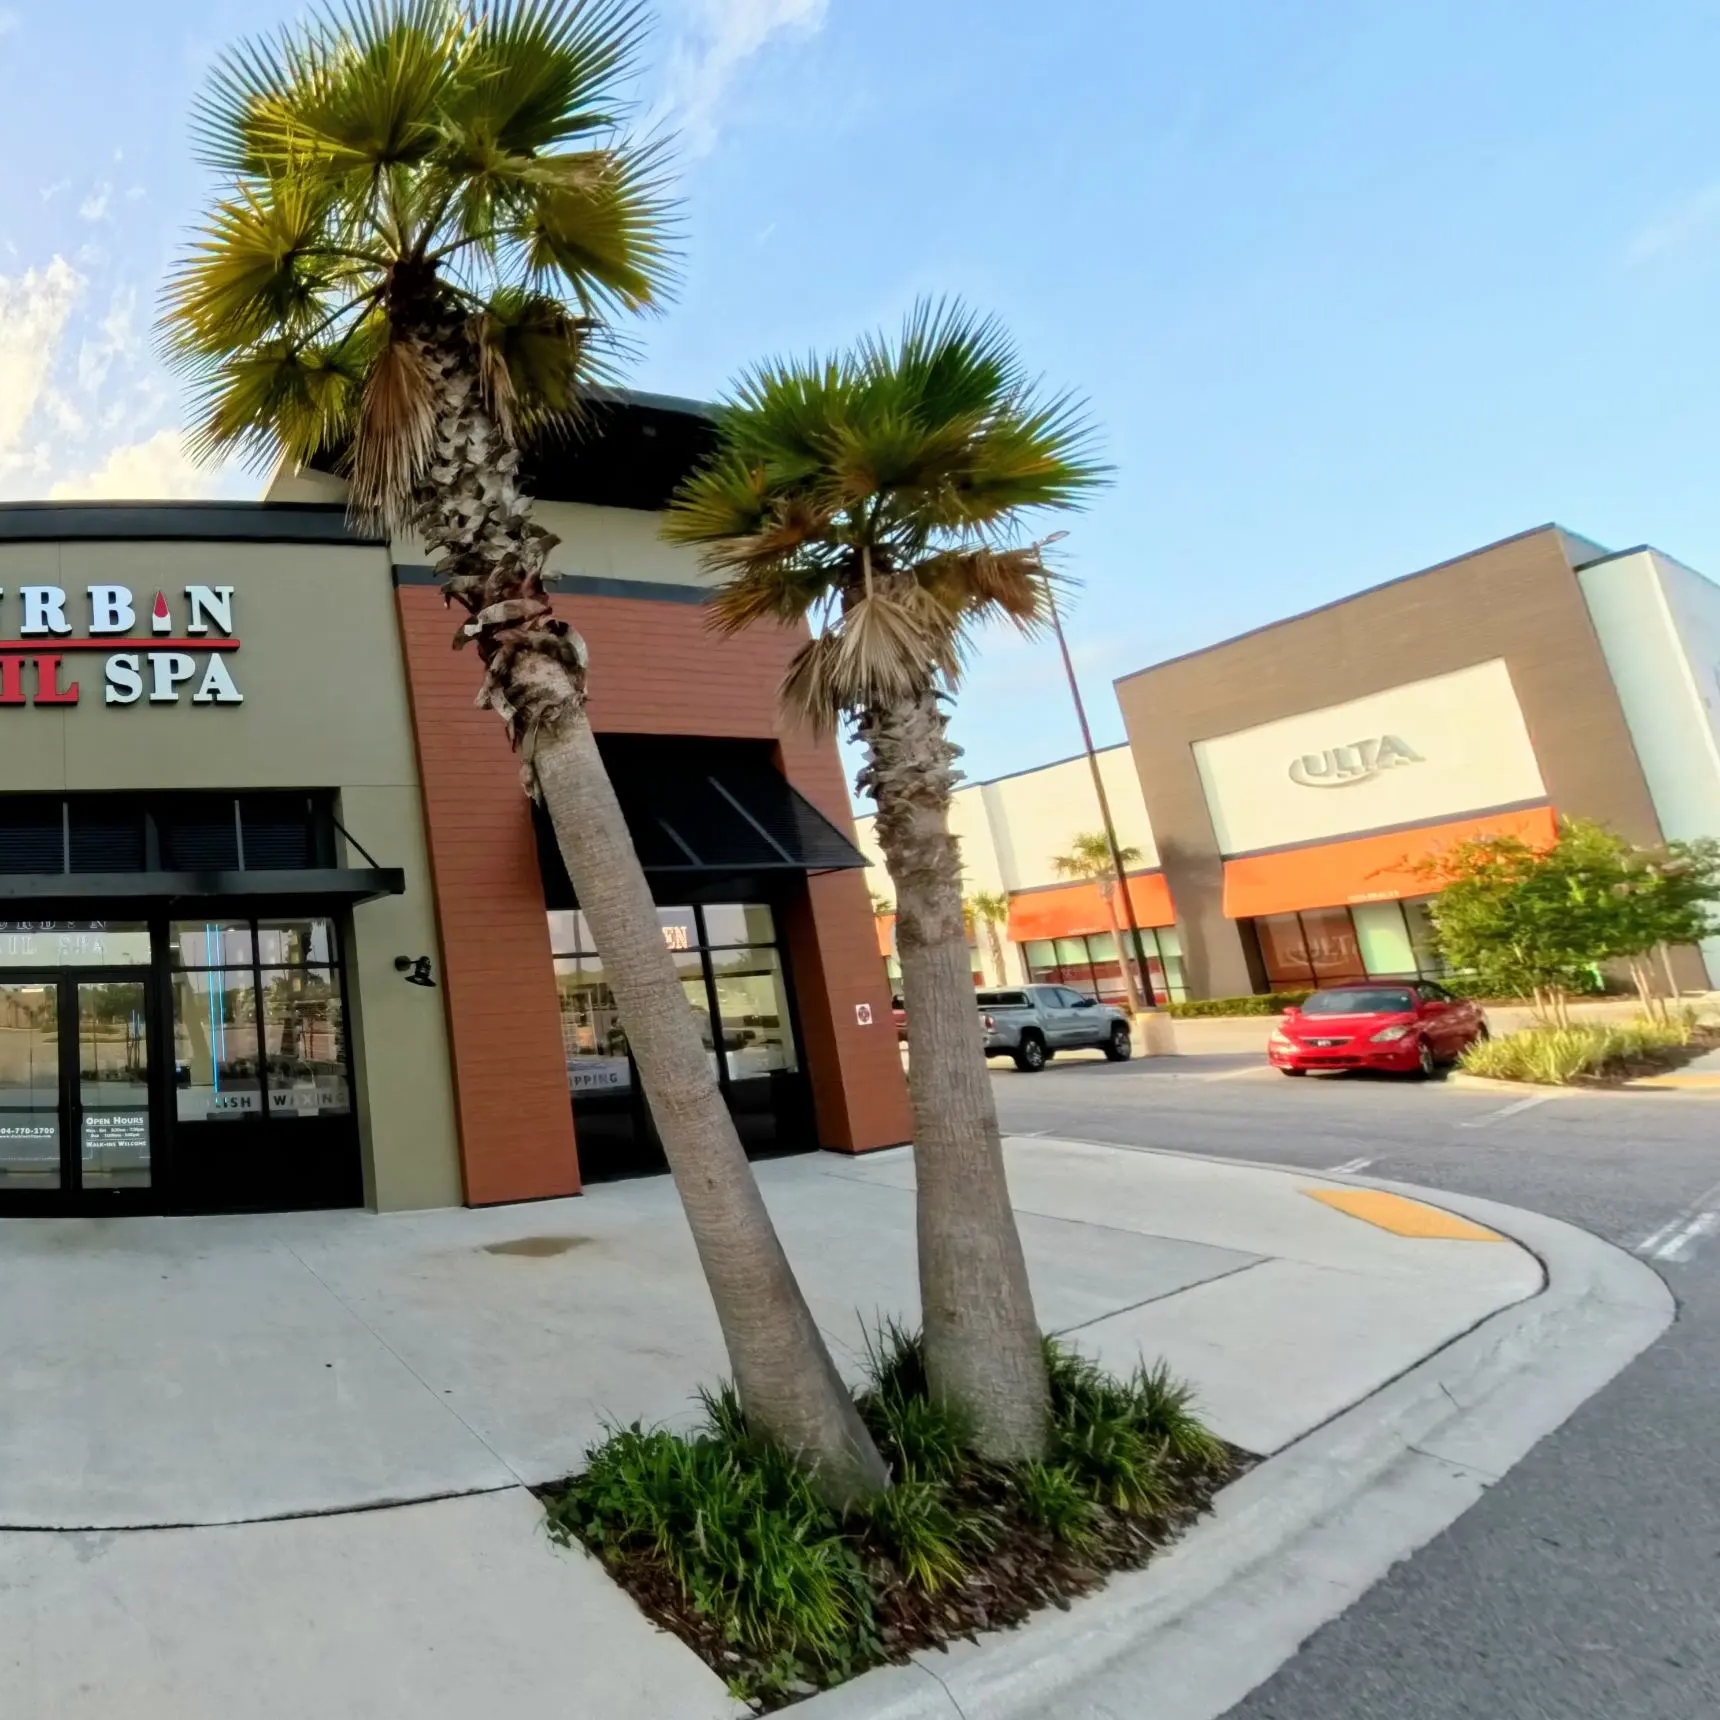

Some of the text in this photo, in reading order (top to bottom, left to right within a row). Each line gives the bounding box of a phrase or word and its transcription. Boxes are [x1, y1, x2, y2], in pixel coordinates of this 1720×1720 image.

[105, 652, 245, 705] SPA
[1299, 734, 1427, 778] ULTA
[662, 926, 689, 950] EN
[568, 1072, 618, 1087] IPPING
[86, 1116, 144, 1125] OPEN HOURS
